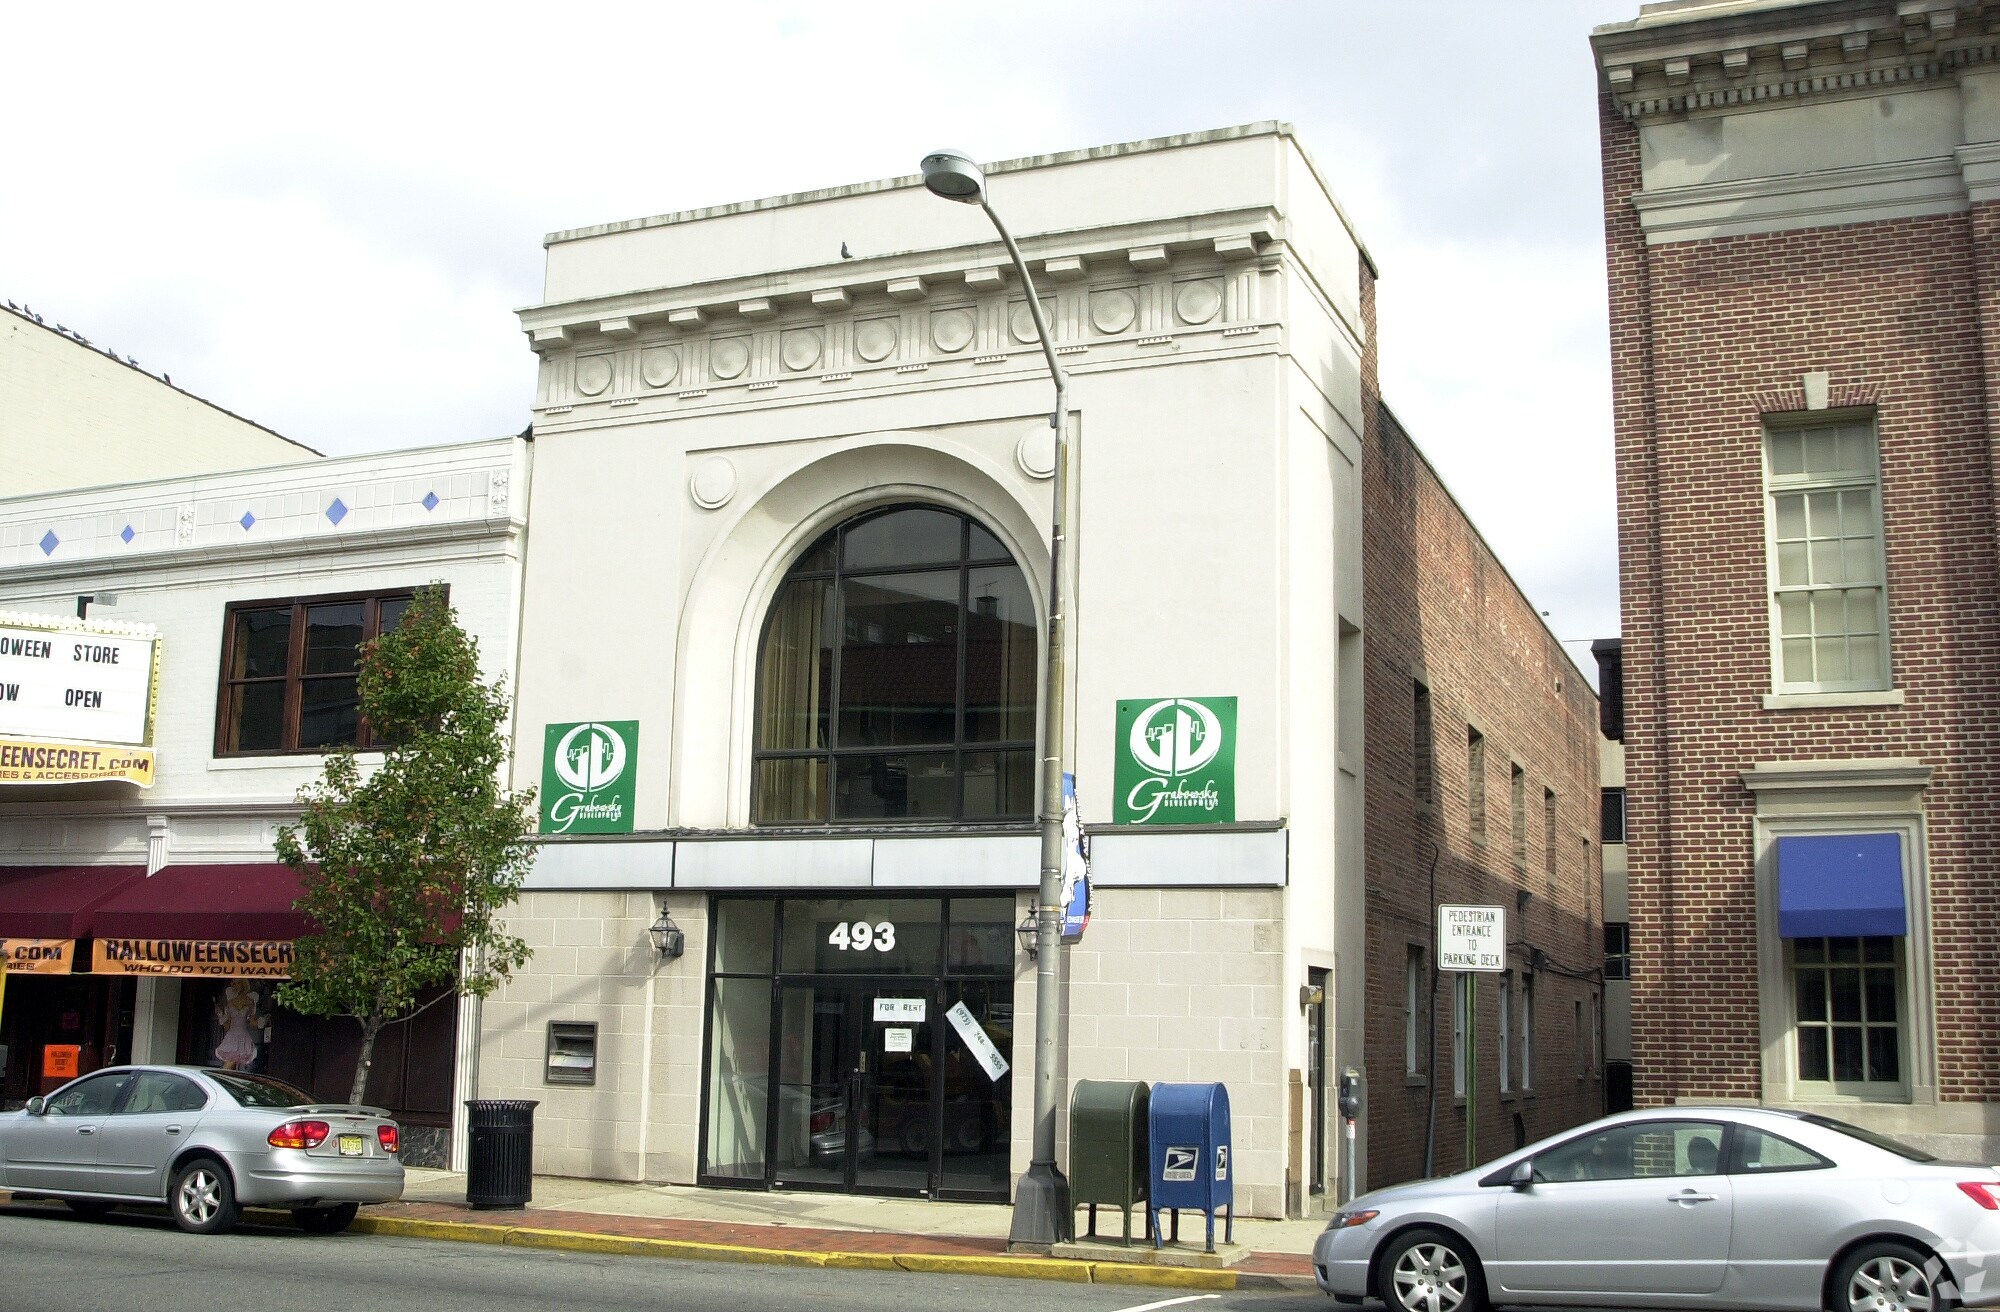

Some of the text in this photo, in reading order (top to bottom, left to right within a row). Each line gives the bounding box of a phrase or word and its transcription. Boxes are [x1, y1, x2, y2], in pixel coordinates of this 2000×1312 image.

[74, 644, 120, 664] STORE
[65, 688, 102, 708] OPEN
[0, 745, 149, 772] EENSECRET.COM
[23, 771, 32, 779] &
[36, 771, 126, 780] ACCESSORIES
[1448, 910, 1495, 923] PEDESTRIAN
[829, 921, 896, 952] 493
[1452, 925, 1491, 937] ENTRANCE
[1468, 938, 1477, 951] TO
[106, 940, 298, 963] HALLOWEENSECR
[1443, 952, 1501, 966] PARKING DECK
[124, 963, 288, 975] WHO DO YOU WAN
[880, 1003, 922, 1013] FOR RENT
